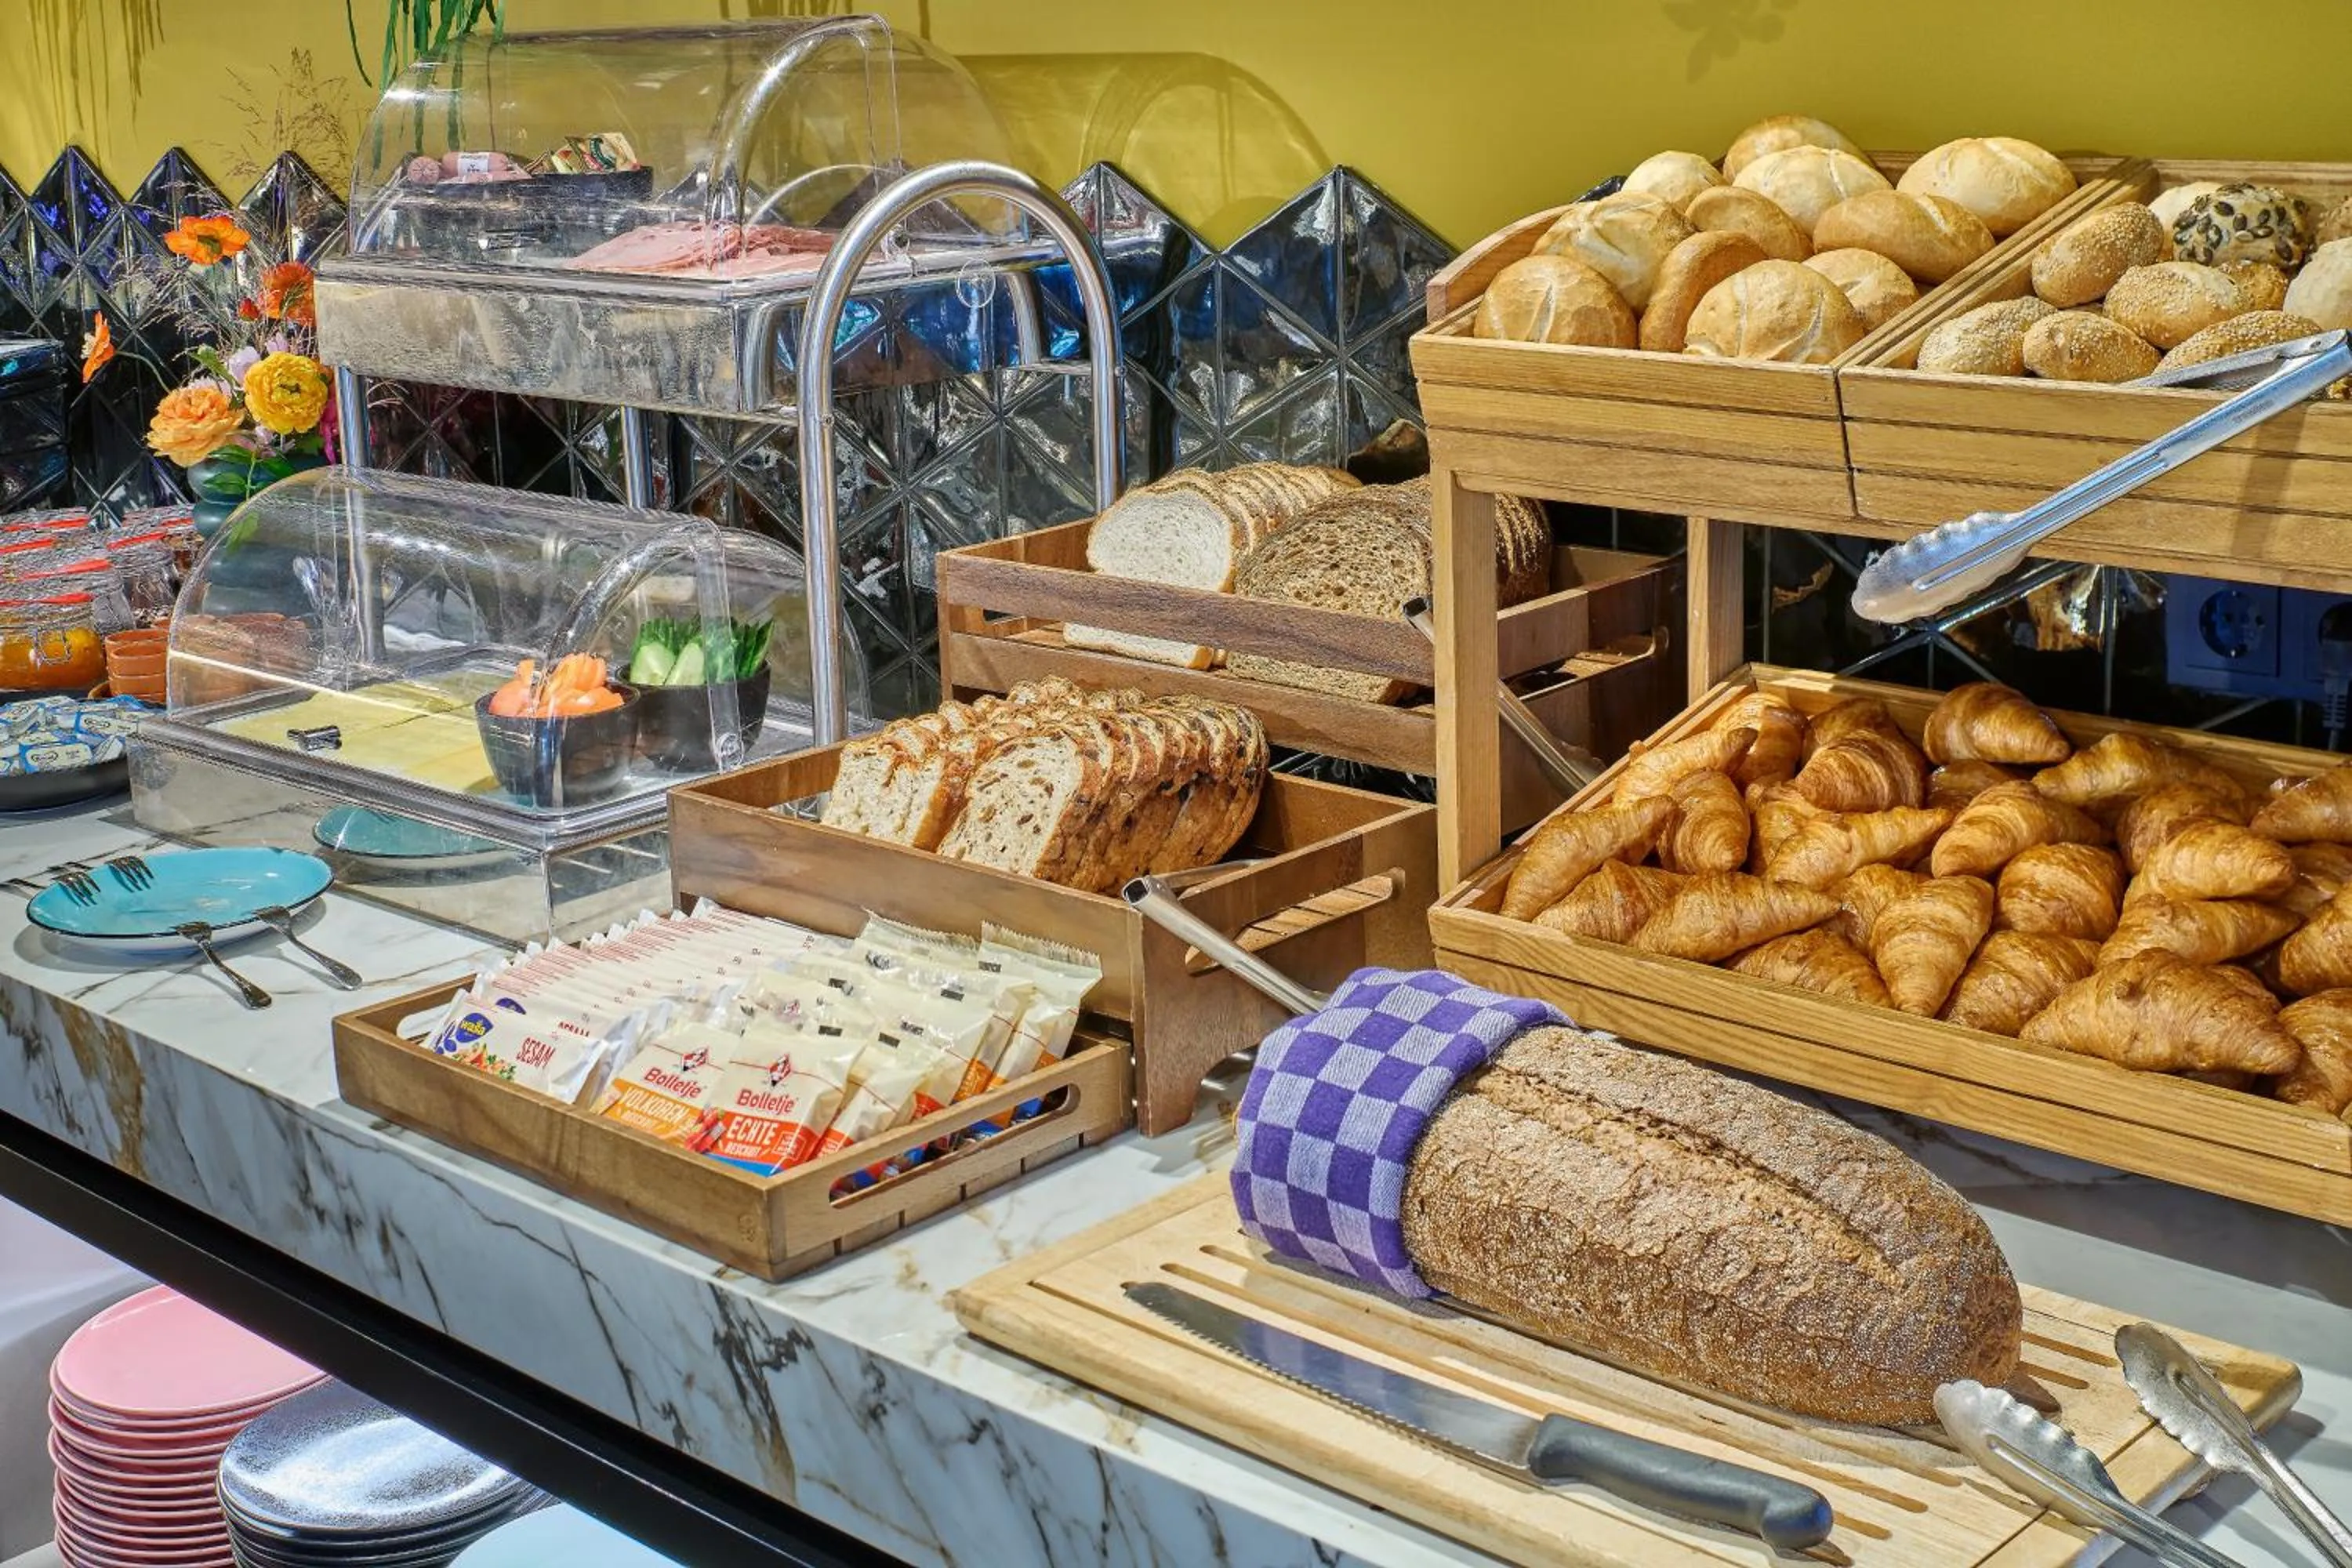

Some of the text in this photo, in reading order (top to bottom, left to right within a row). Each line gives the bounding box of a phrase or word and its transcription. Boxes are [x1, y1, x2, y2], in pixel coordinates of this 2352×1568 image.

[644, 1067, 702, 1099] Bolletje
[735, 1088, 795, 1116] Bolletje
[726, 1116, 780, 1146] ECHTE
